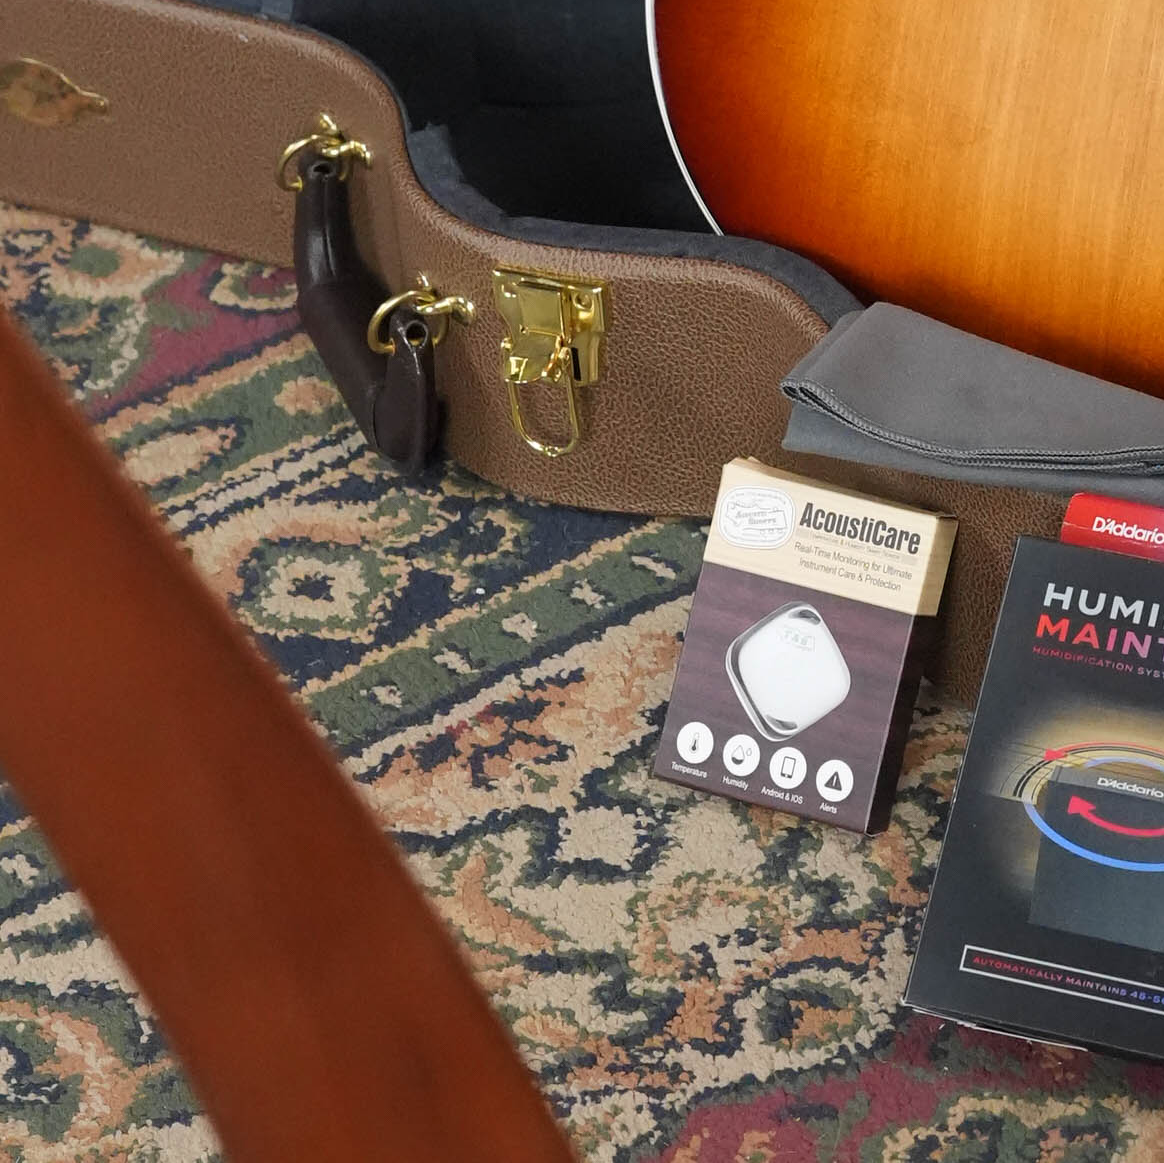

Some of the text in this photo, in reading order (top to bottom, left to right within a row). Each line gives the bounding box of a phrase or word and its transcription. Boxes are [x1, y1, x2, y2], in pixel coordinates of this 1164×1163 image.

[799, 502, 921, 555] AcoustiCare
[794, 541, 832, 560] Real-Time
[833, 551, 870, 571] Monitoring
[871, 561, 881, 572] for
[882, 565, 913, 581] Ultimate
[799, 558, 838, 576] Instrument
[838, 567, 857, 580] Care
[864, 574, 902, 591] Protection
[1033, 646, 1133, 672] HUMIDIFICATION
[671, 761, 708, 779] Temperature
[722, 775, 749, 791] Humidity
[760, 786, 785, 800] Android
[819, 802, 838, 814] Alerts
[972, 956, 1063, 982] AUTOMATICALLY
[1065, 976, 1127, 996] MAINTAINS
